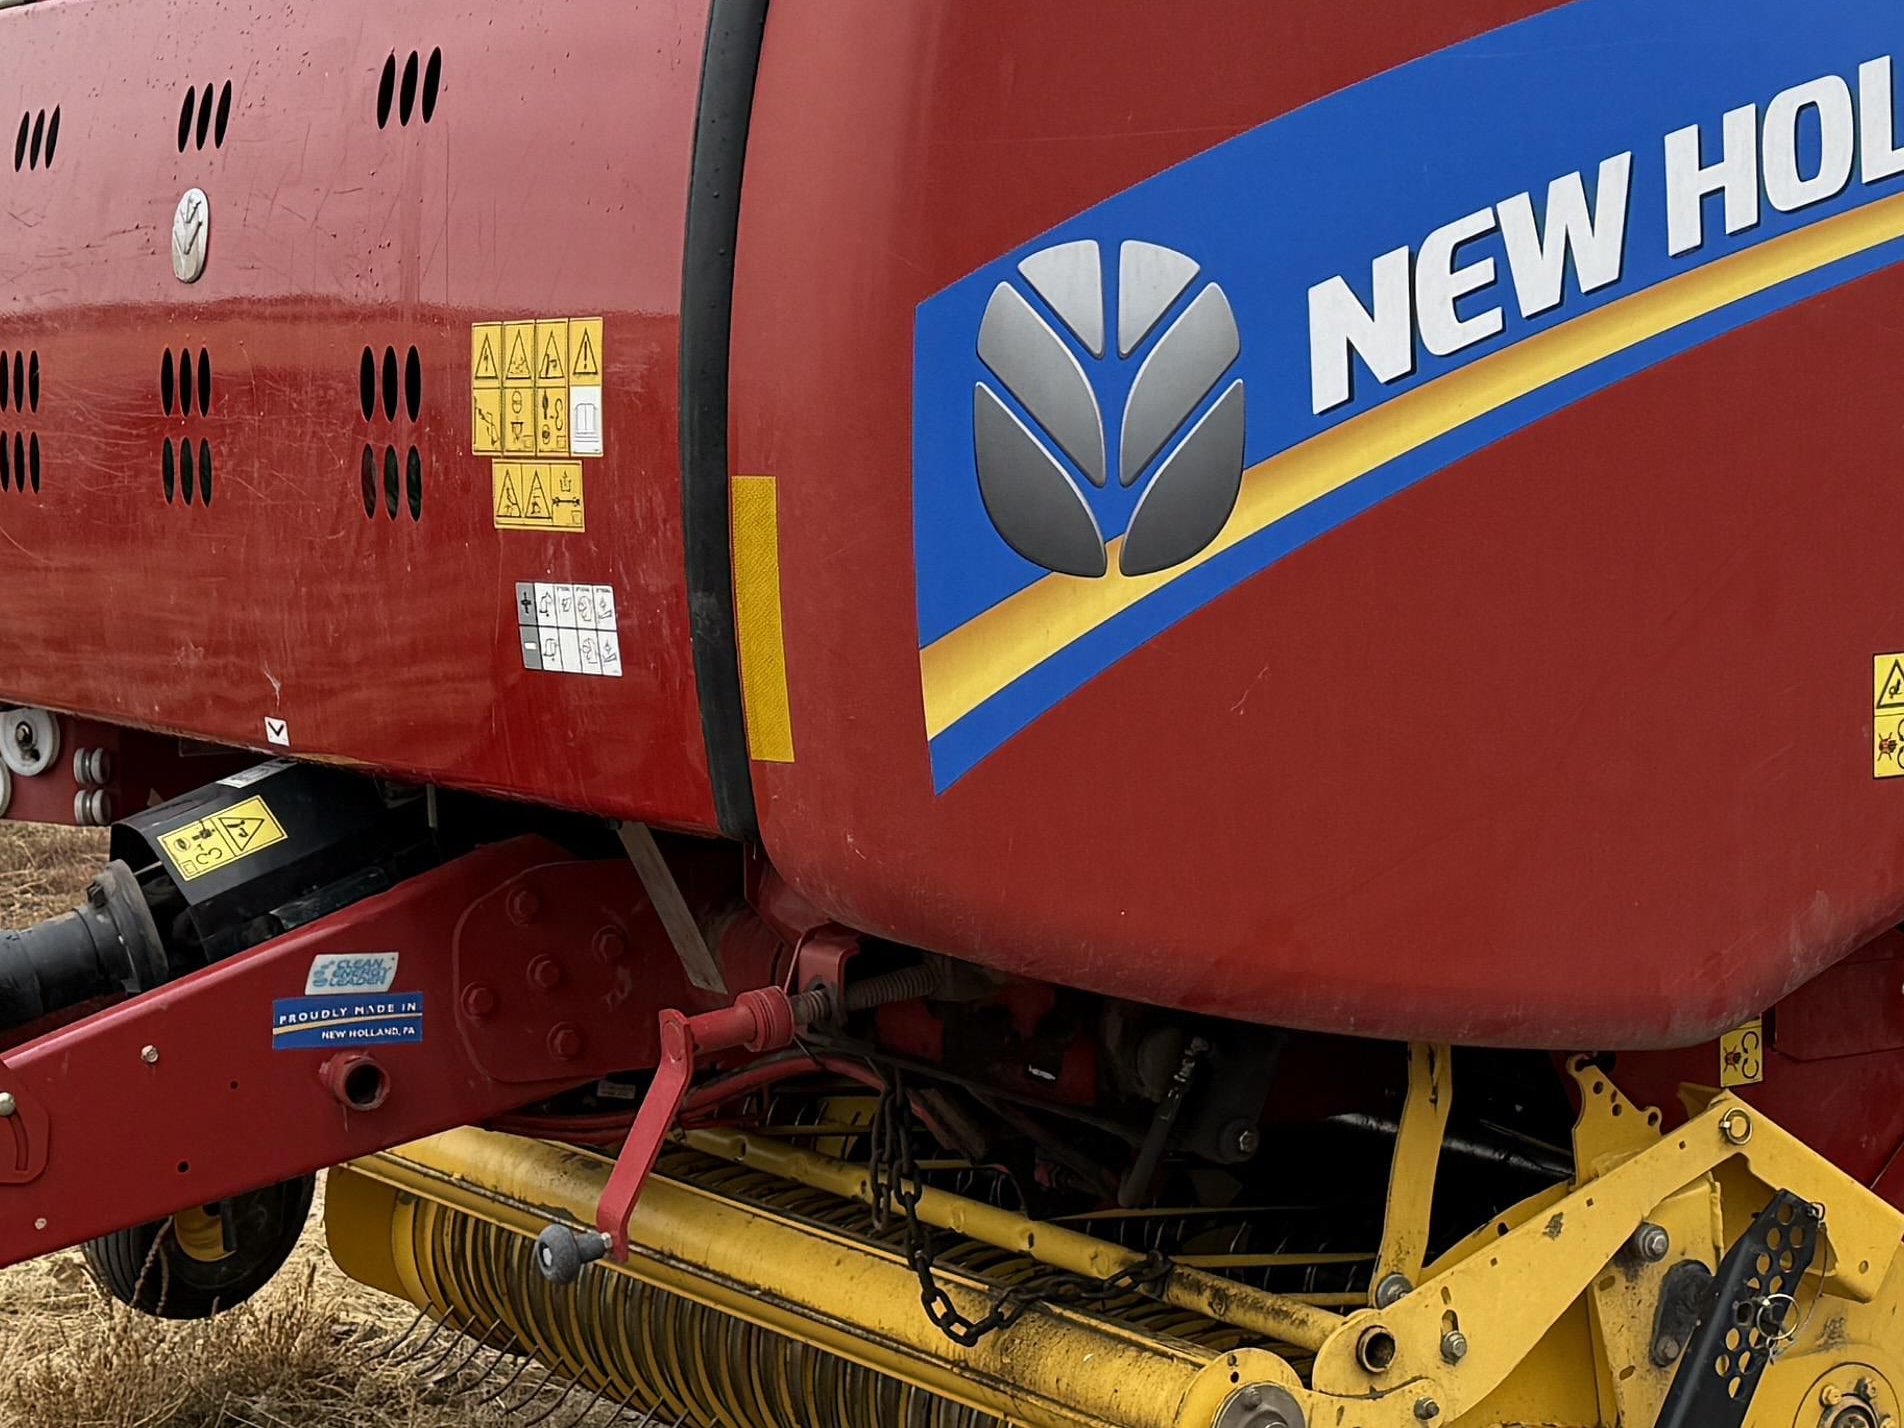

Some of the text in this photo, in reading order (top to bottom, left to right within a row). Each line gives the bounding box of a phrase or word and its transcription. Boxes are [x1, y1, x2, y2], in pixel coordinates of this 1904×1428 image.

[1307, 151, 1632, 415] NEW
[336, 957, 384, 970] CLEAN
[279, 1002, 417, 1025] PROUDLY MADE IN
[321, 1030, 347, 1040] NEW
[402, 1026, 416, 1035] PA
